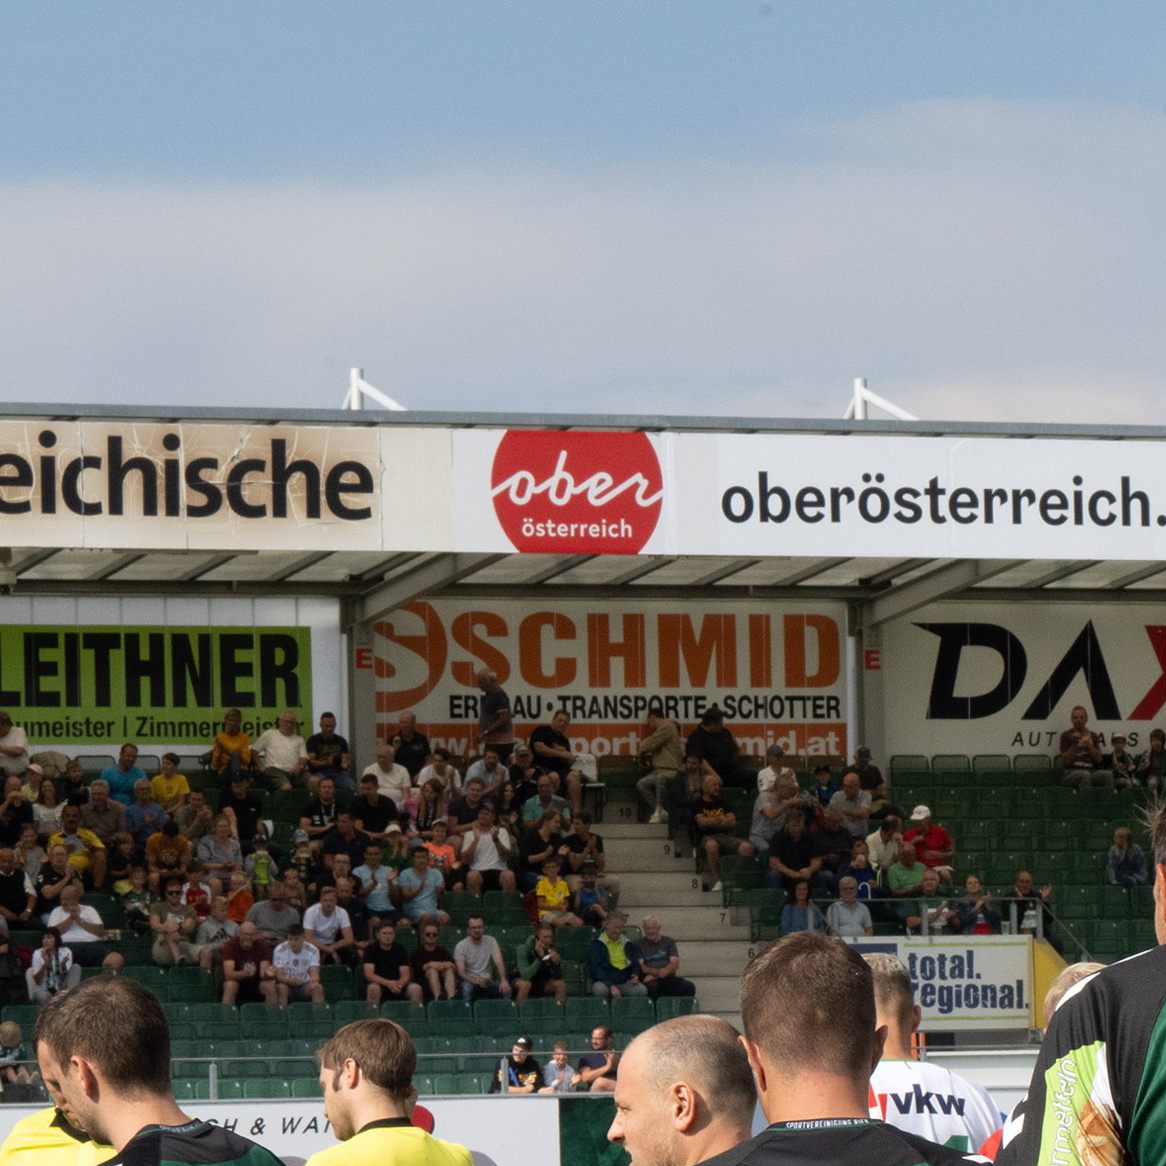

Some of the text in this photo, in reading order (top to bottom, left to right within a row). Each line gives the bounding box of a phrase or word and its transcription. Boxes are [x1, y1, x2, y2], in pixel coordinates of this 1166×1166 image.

[0, 430, 374, 521] eichische
[491, 450, 664, 507] ober
[521, 516, 634, 539] österreich
[451, 611, 841, 690] SCHMID
[449, 694, 841, 720] ERAU TRANSPORTE SCHOTTER
[908, 950, 981, 981] total.
[890, 1084, 966, 1117] vkw
